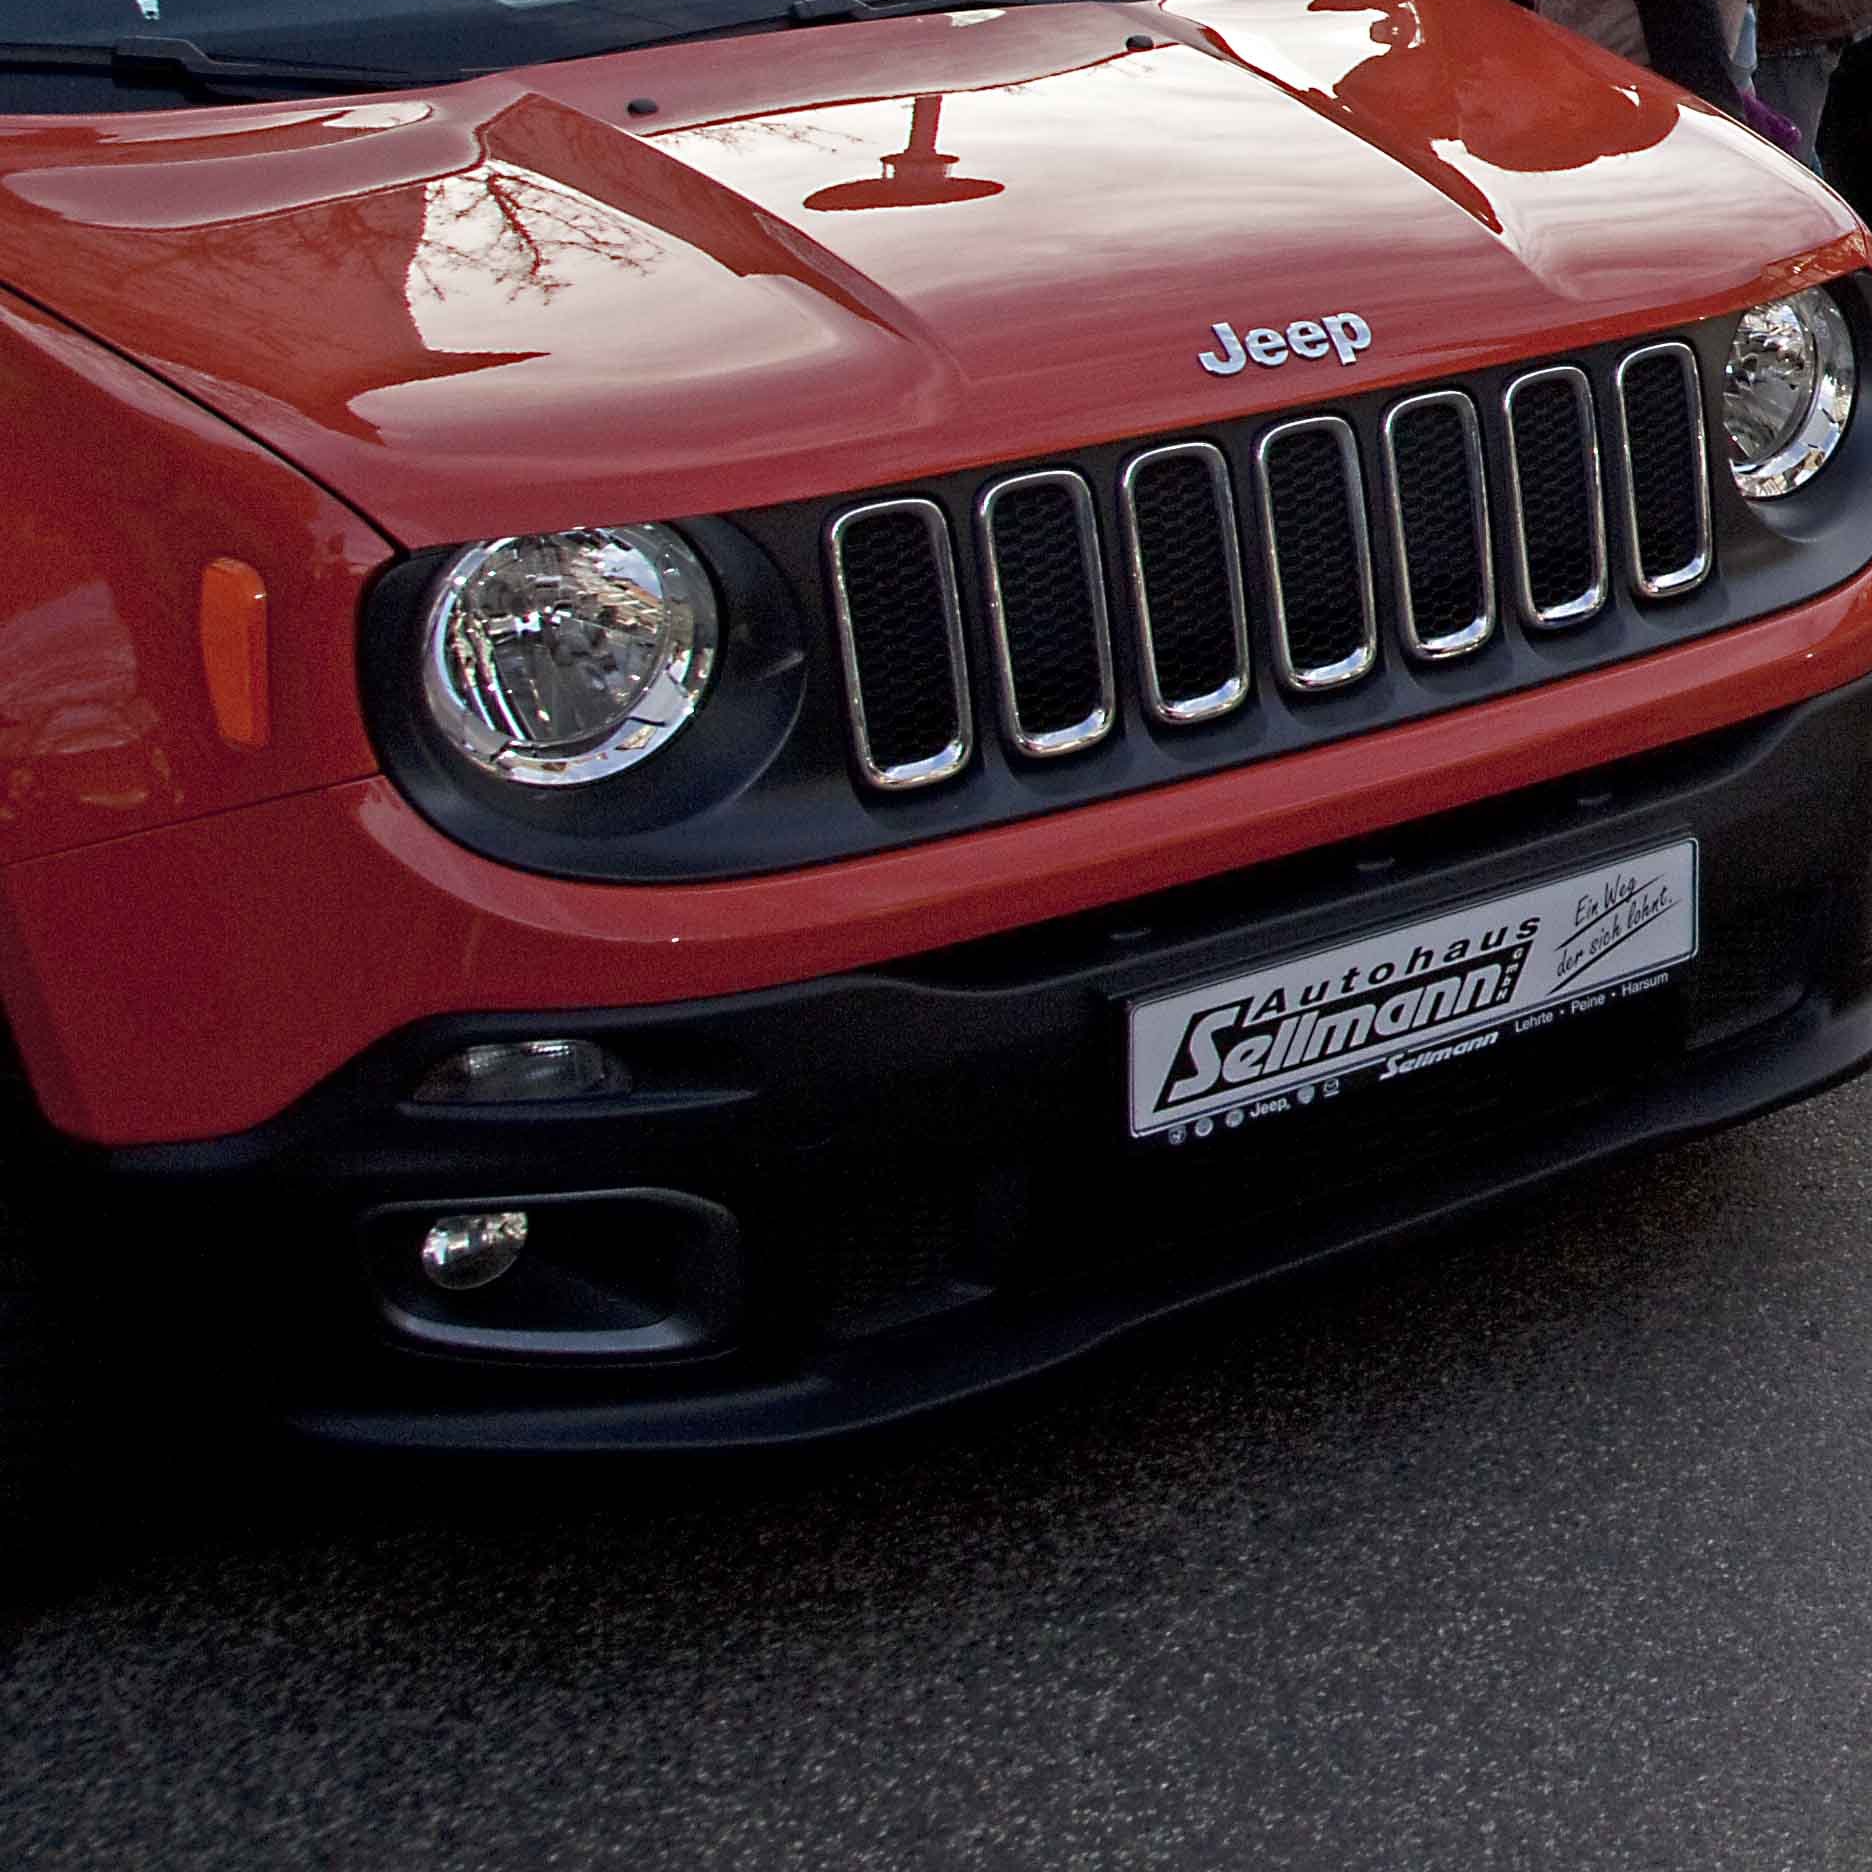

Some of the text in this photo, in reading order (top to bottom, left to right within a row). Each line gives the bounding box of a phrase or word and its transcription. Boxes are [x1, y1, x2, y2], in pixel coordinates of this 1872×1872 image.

[1197, 312, 1373, 376] Jeep
[1575, 874, 1637, 927] Ein Weg
[1251, 916, 1541, 1021] Autohaus
[1556, 947, 1584, 977] der
[1590, 914, 1621, 955] sich
[1166, 962, 1502, 1104] Sellmann
[1514, 971, 1670, 1033] Lehrte Peine Harsum
[1379, 1031, 1499, 1081] Sellmann
